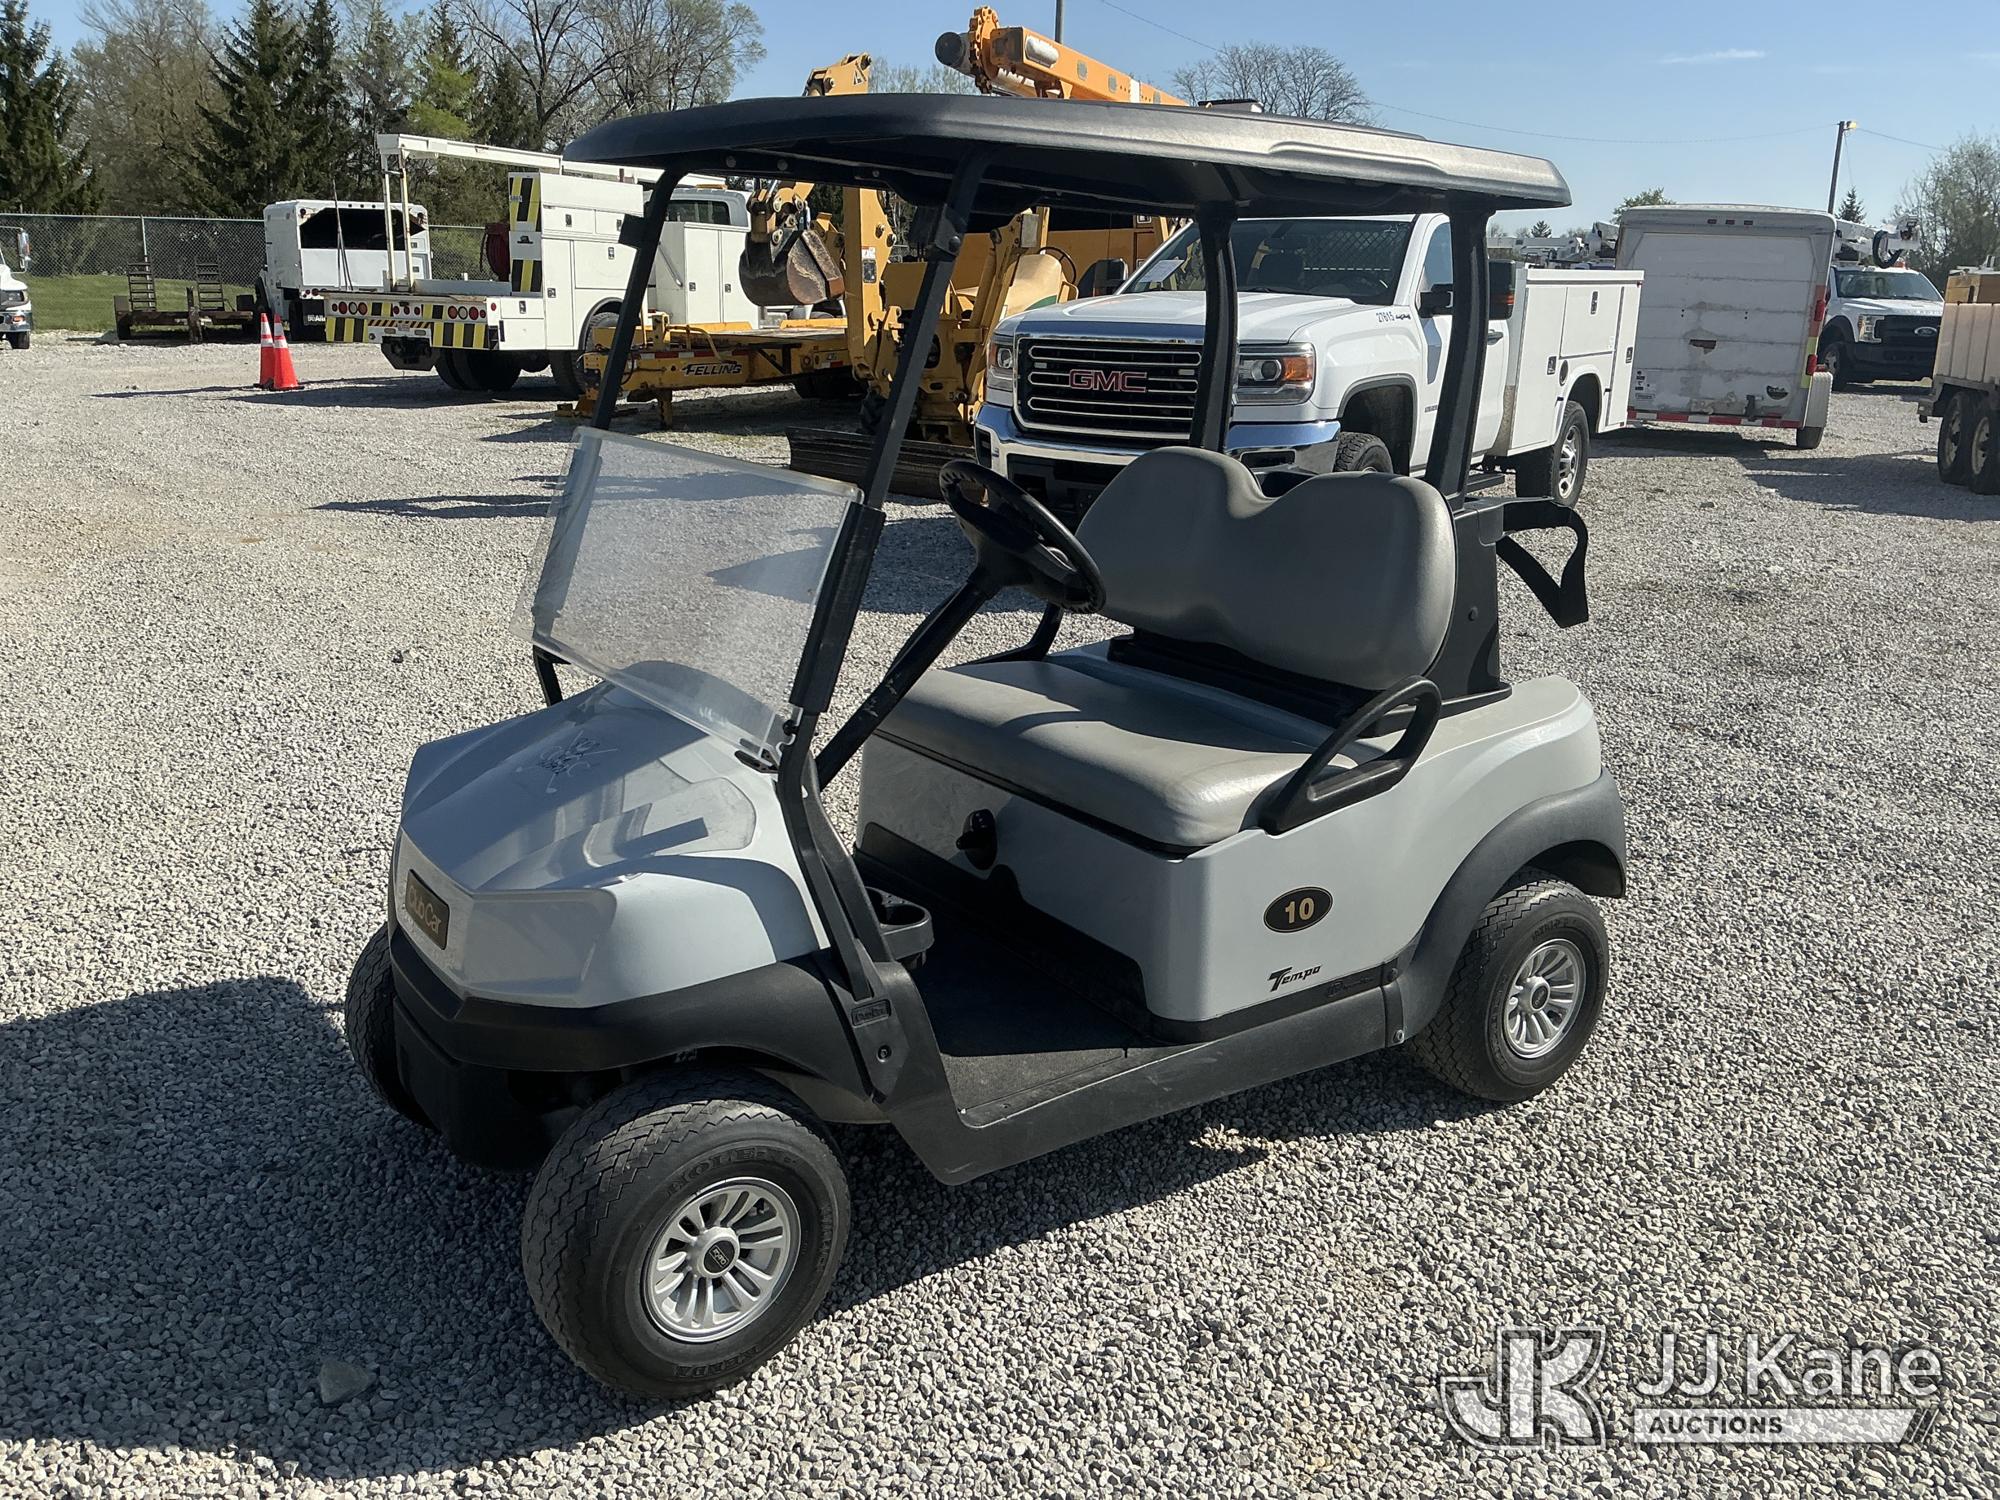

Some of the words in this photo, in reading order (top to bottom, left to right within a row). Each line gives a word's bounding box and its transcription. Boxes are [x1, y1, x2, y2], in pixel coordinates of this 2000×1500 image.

[1069, 368, 1147, 393] GMC
[1285, 897, 1315, 924] 10
[1267, 966, 1322, 992] Tempo
